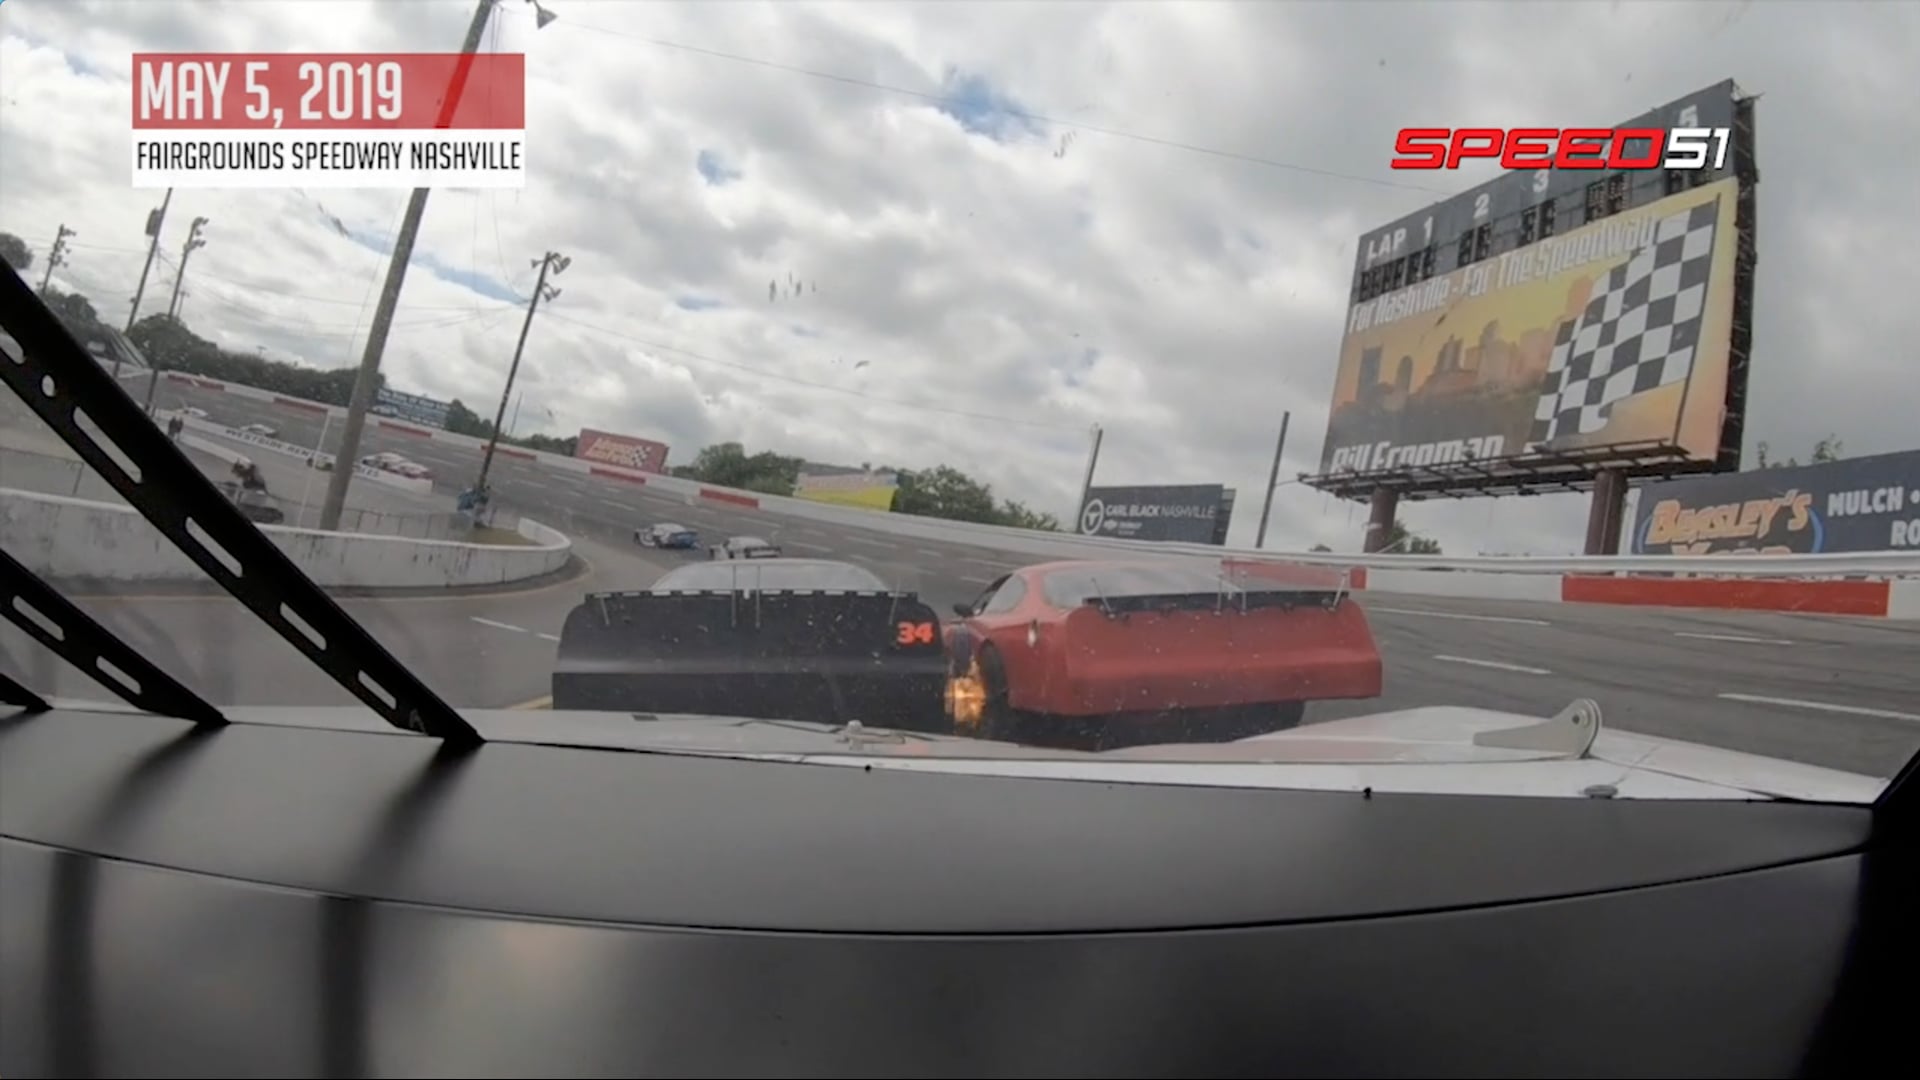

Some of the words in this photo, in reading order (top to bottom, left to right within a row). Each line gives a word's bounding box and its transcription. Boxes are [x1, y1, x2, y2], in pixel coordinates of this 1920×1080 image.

[1366, 227, 1407, 263] LAP
[1423, 215, 1434, 242] 1
[1473, 192, 1490, 219] 2
[1532, 169, 1549, 193] 3
[1348, 303, 1377, 335] For
[1375, 277, 1450, 325] Nashville
[1463, 264, 1494, 297] For
[1498, 251, 1531, 289] The
[1105, 503, 1128, 518] CARL
[1128, 503, 1160, 518] BLACK
[1160, 503, 1218, 519] NASHVILLE
[1827, 486, 1904, 517] MULCH
[897, 621, 934, 644] 34
